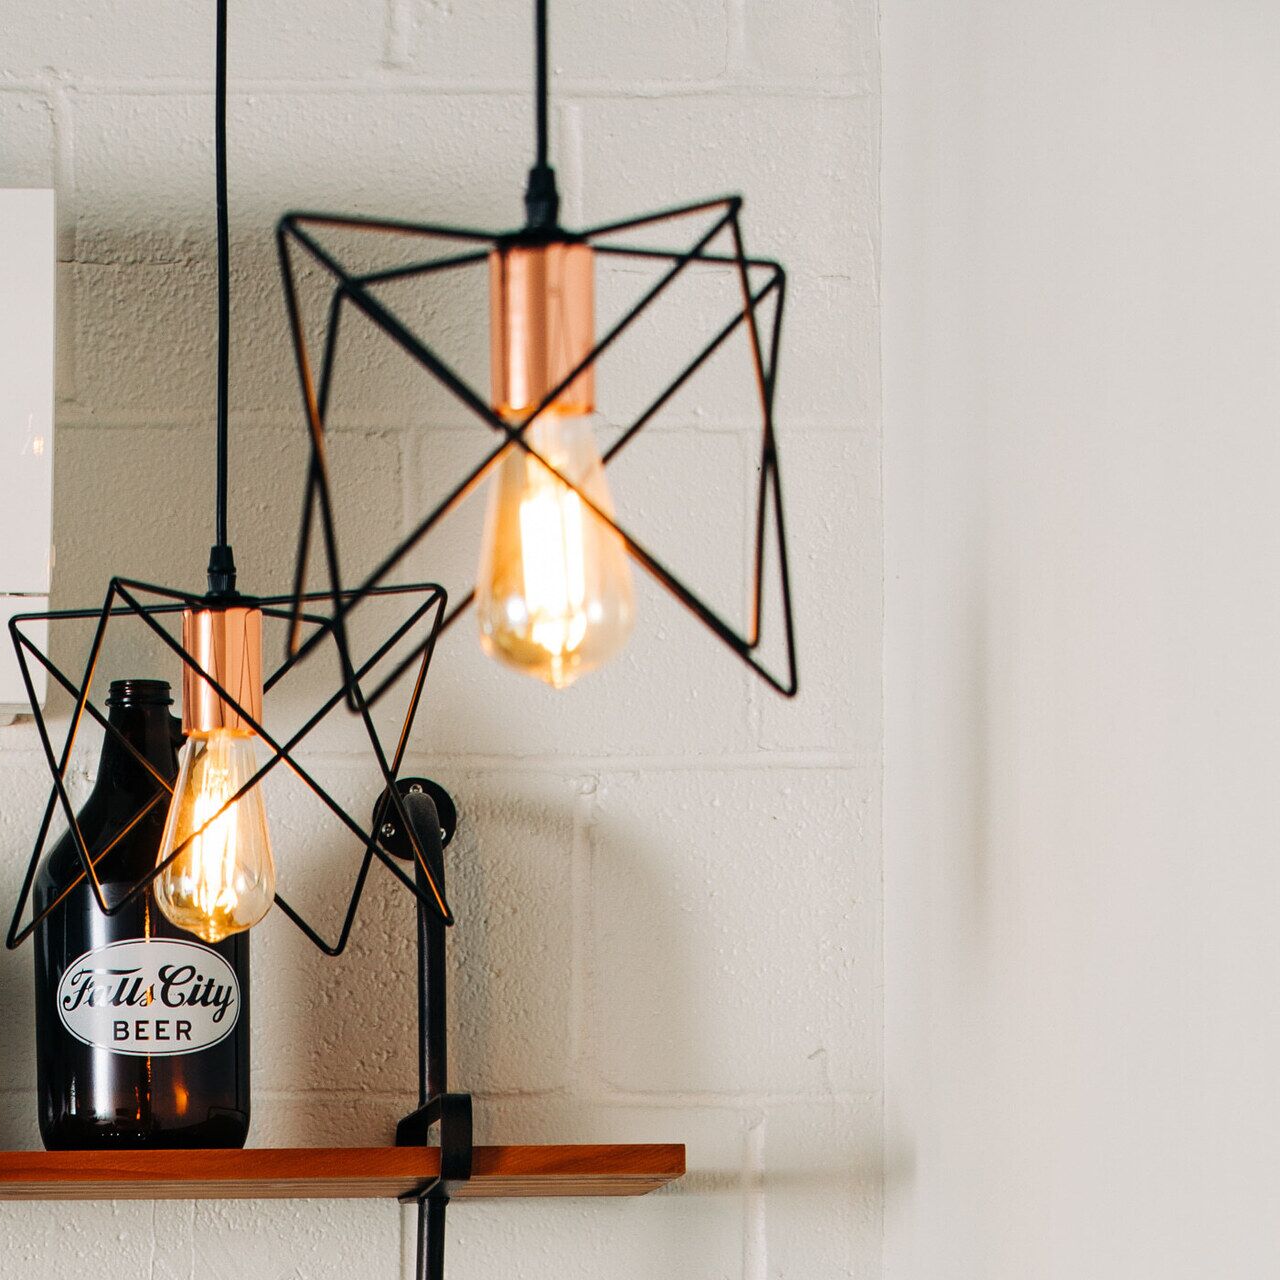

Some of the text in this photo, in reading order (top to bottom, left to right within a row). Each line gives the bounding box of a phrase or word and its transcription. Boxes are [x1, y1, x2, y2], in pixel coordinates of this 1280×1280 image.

[62, 964, 235, 1024] Falls City
[112, 1019, 193, 1042] BEER
